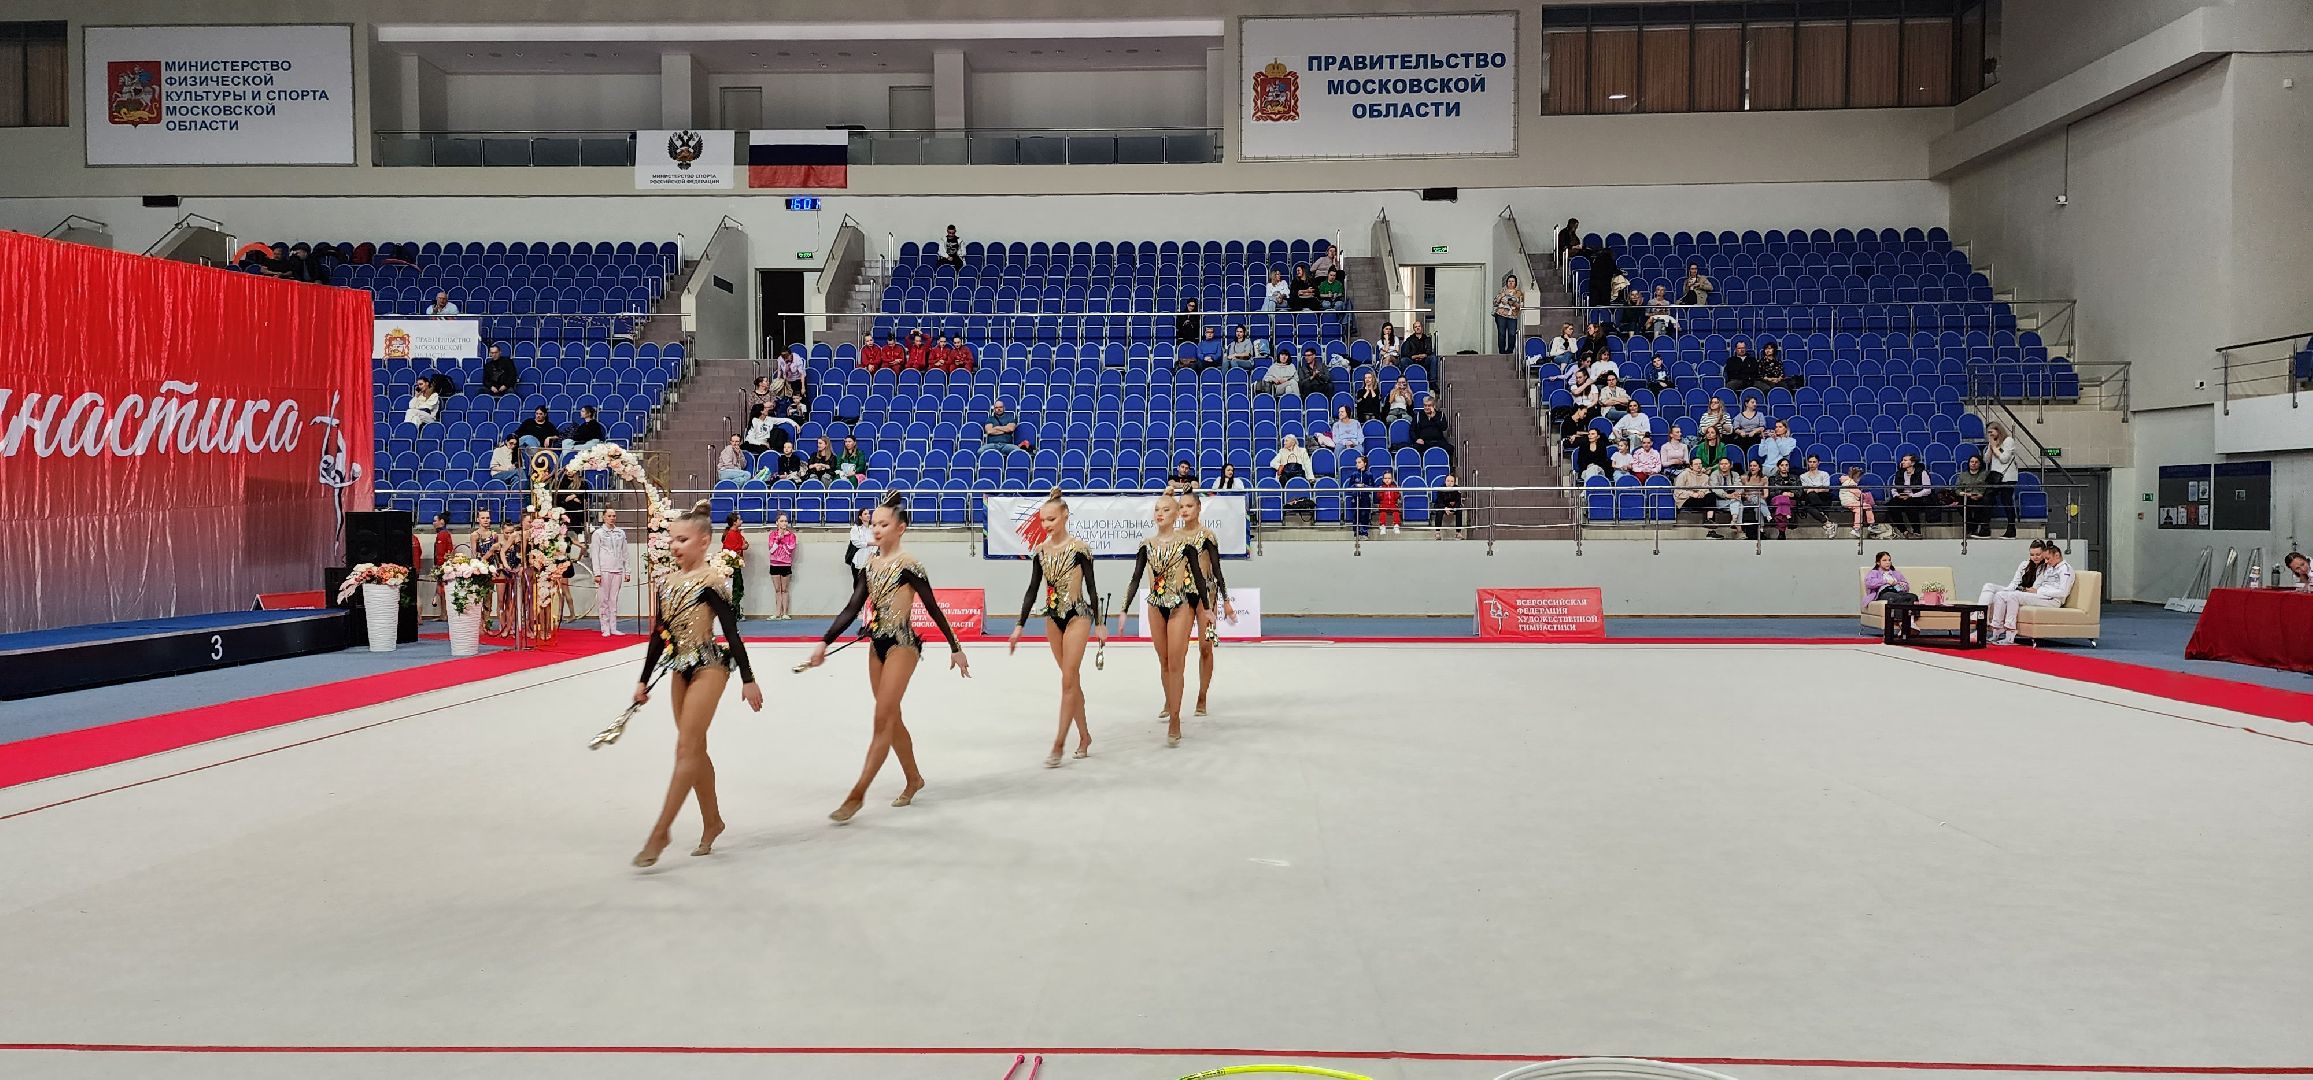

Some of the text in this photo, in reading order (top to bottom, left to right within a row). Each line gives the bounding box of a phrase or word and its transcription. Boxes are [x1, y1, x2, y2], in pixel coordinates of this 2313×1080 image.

[164, 60, 292, 72] МИНИСТЕРСТВО
[1308, 53, 1507, 71] ПРАВИТЕЛЬСТВО
[164, 74, 274, 87] ФИЗИЧЕСКОЙ
[1327, 74, 1486, 95] МОСКОВСКОЙ
[165, 89, 330, 102] КУЛЬТУРЫ И СПОРТА
[165, 103, 276, 116] МОСКОВСКОЙ
[1352, 102, 1461, 119] ОБЛАСТИ
[166, 119, 239, 131] ОБЛАСТИ
[211, 635, 223, 660] 3
